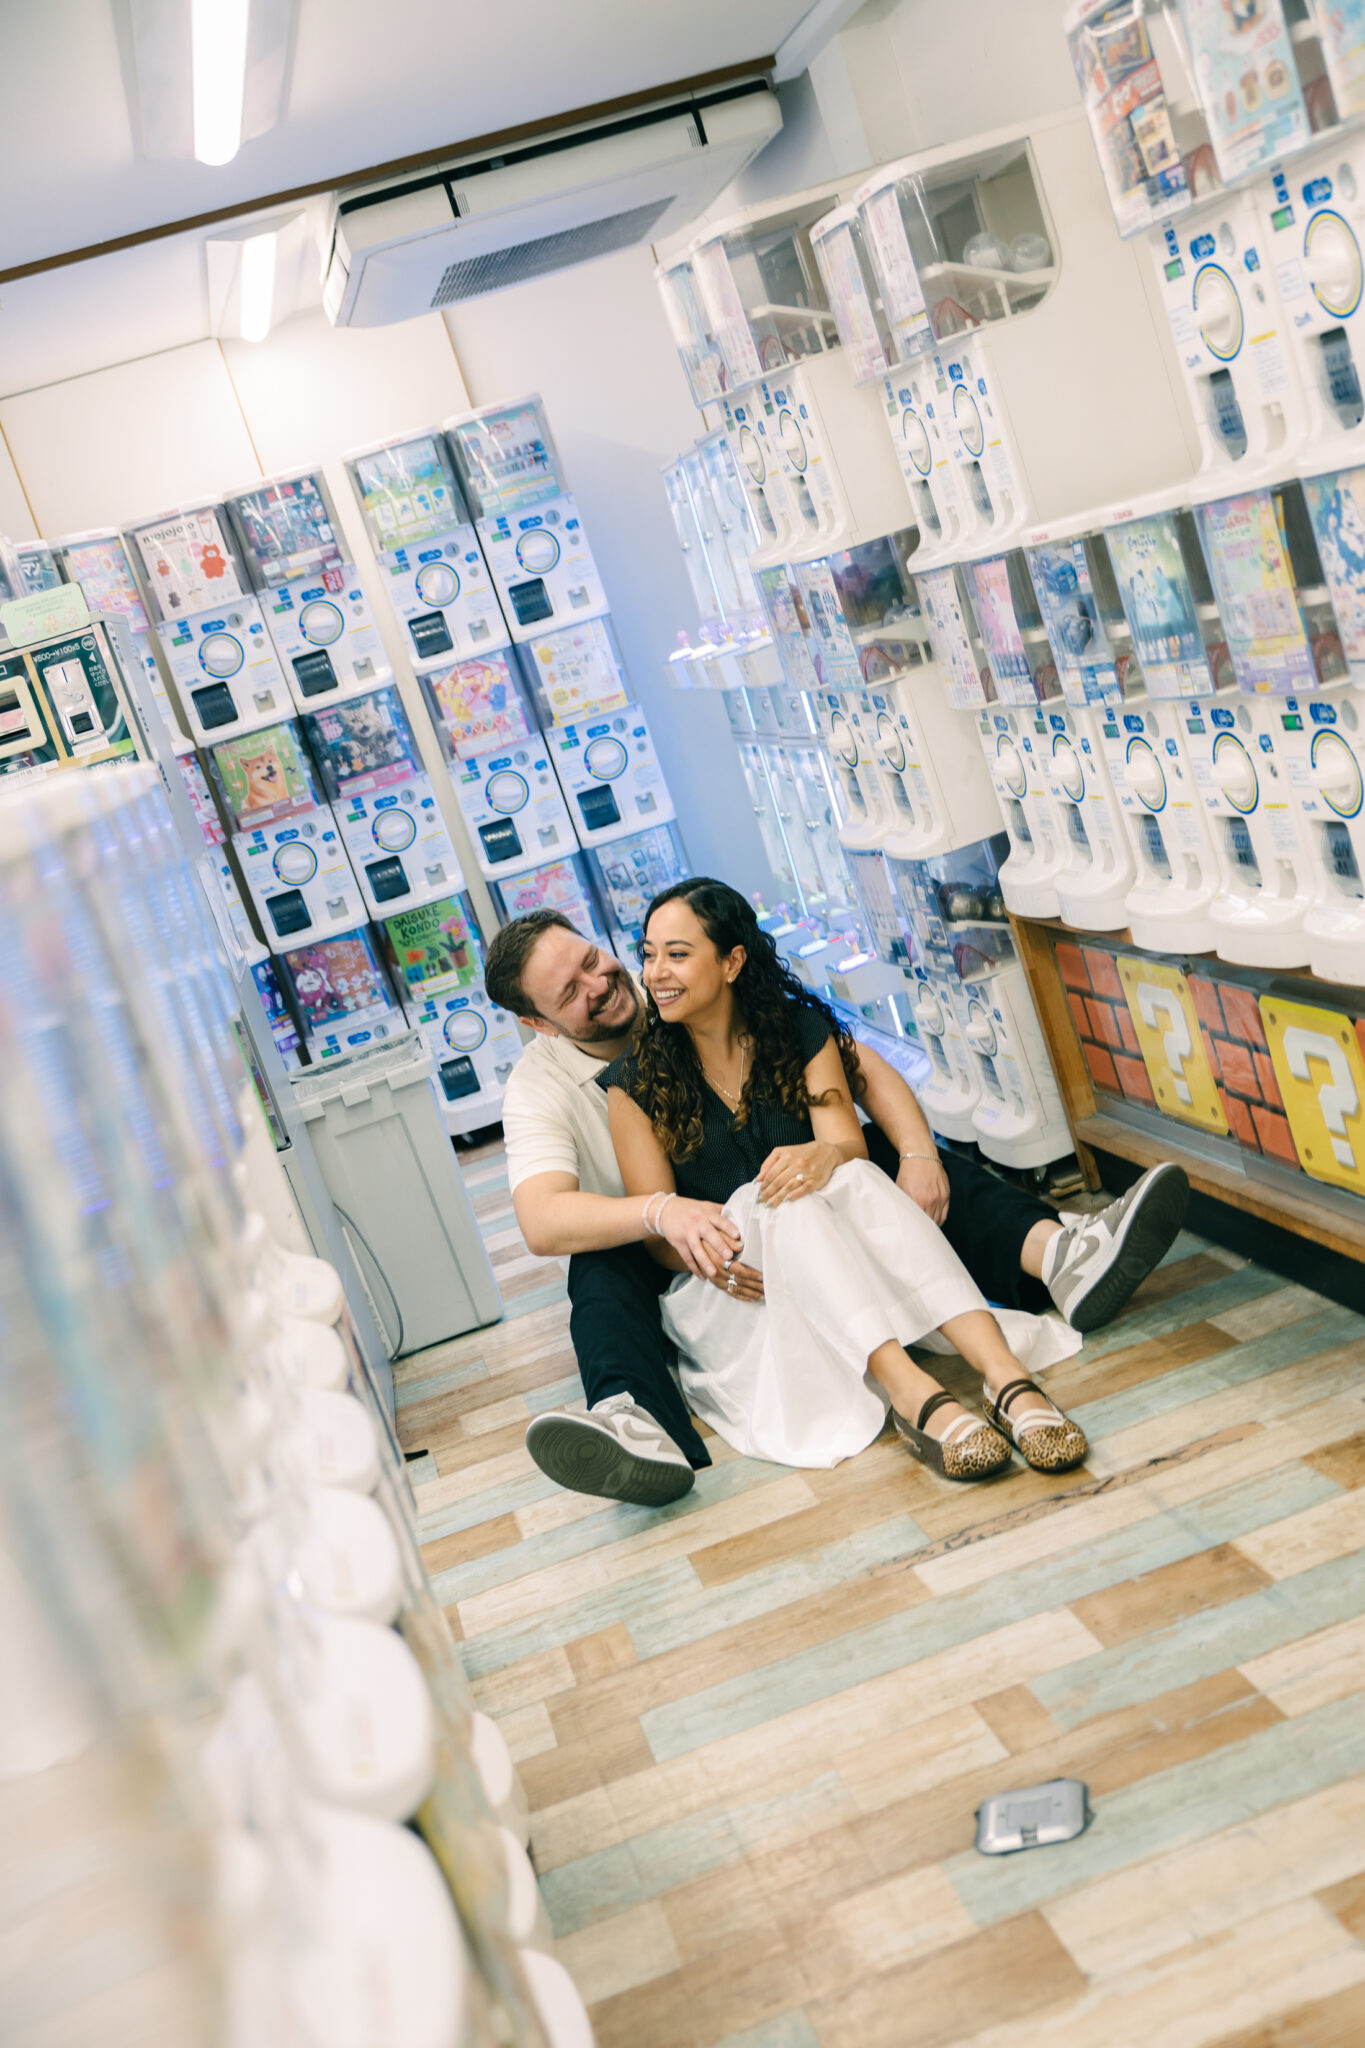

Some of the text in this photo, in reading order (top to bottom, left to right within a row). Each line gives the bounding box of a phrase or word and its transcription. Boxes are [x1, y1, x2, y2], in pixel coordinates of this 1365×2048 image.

[393, 905, 440, 930] DAISUKE
[401, 918, 440, 940] KONDO
[1137, 981, 1192, 1104] ?
[1283, 1026, 1360, 1169] ?
